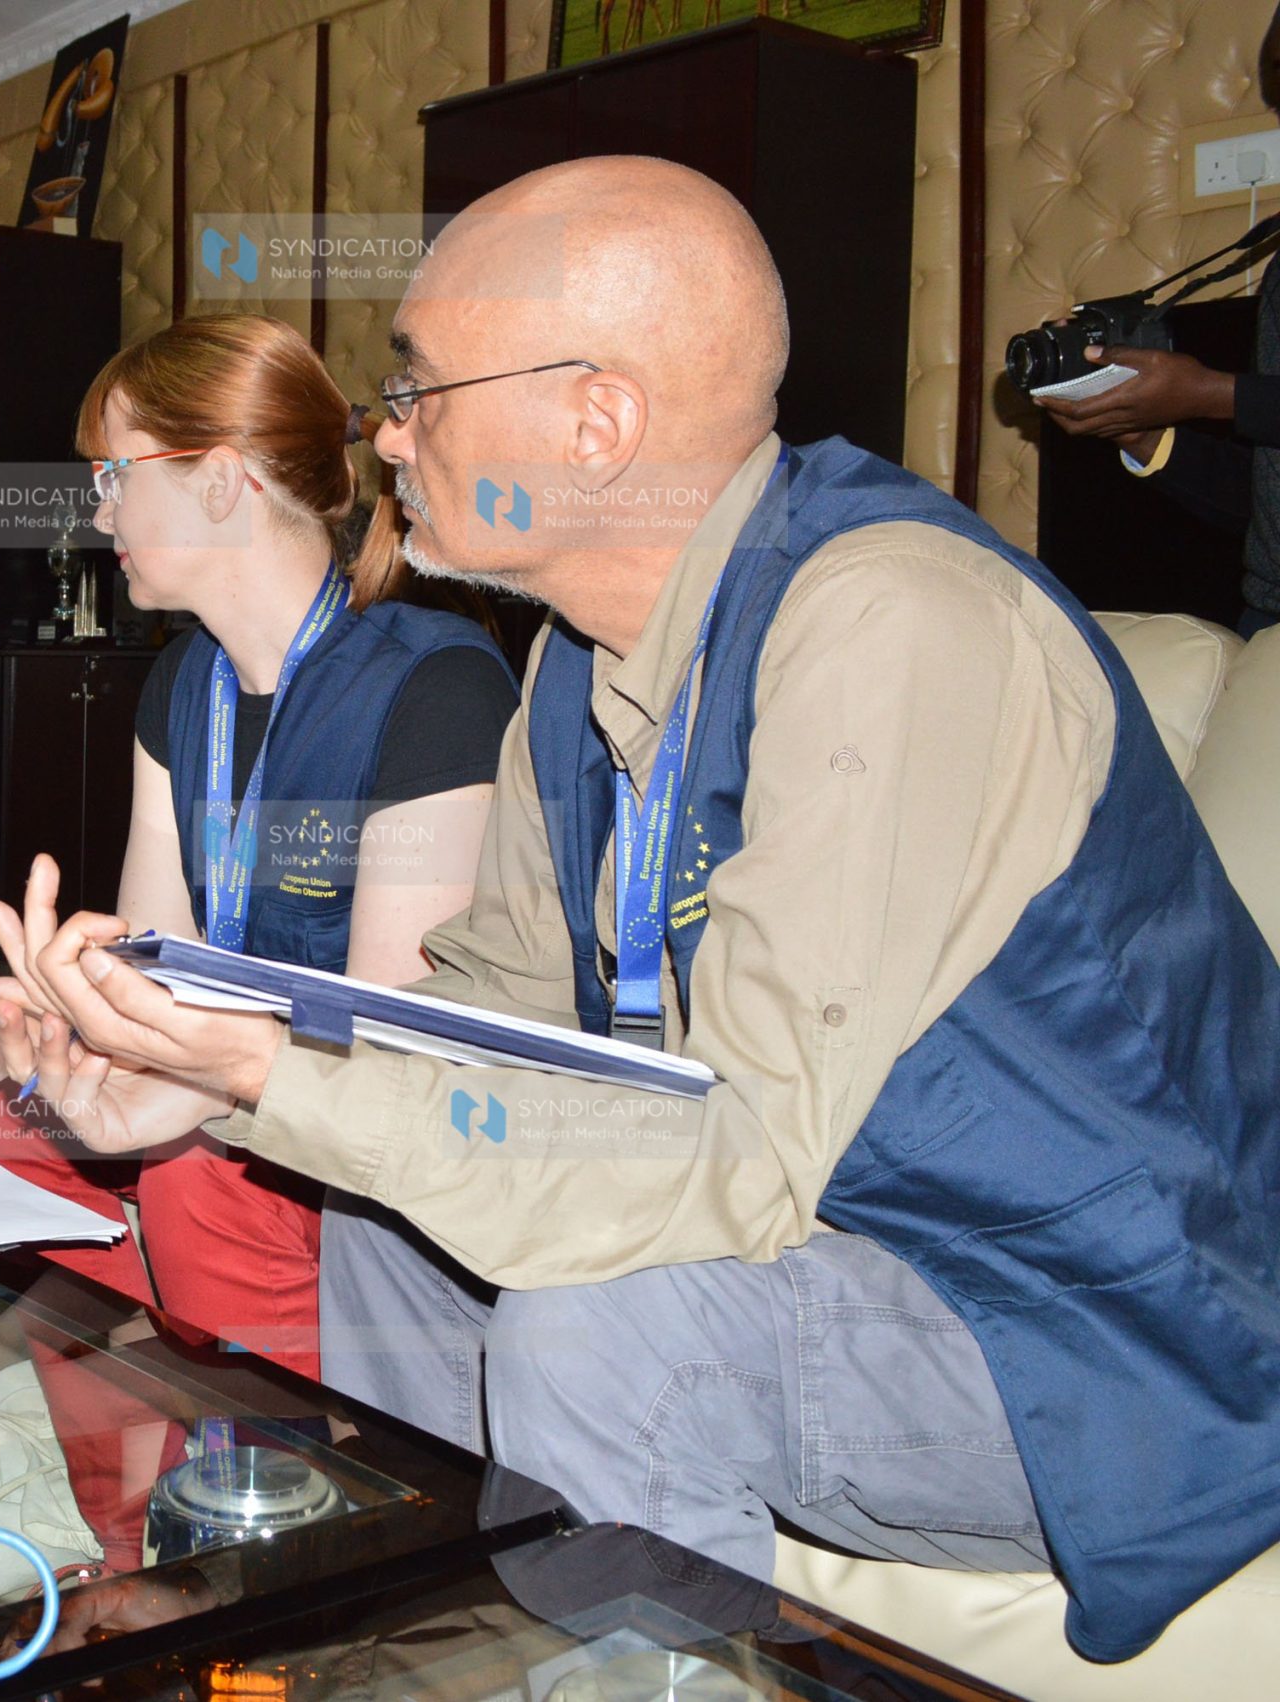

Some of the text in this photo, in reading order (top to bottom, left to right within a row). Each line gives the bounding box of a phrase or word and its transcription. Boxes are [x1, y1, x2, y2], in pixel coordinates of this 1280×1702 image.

[214, 680, 223, 711] Election
[213, 712, 221, 759] Observation
[221, 704, 229, 742] European
[623, 798, 631, 838] Election
[640, 800, 661, 880] European Union
[648, 770, 675, 913] Election Observation Mission
[303, 887, 338, 898] Observer
[310, 877, 332, 888] Union
[234, 888, 245, 919] Election
[671, 907, 709, 929] Election
